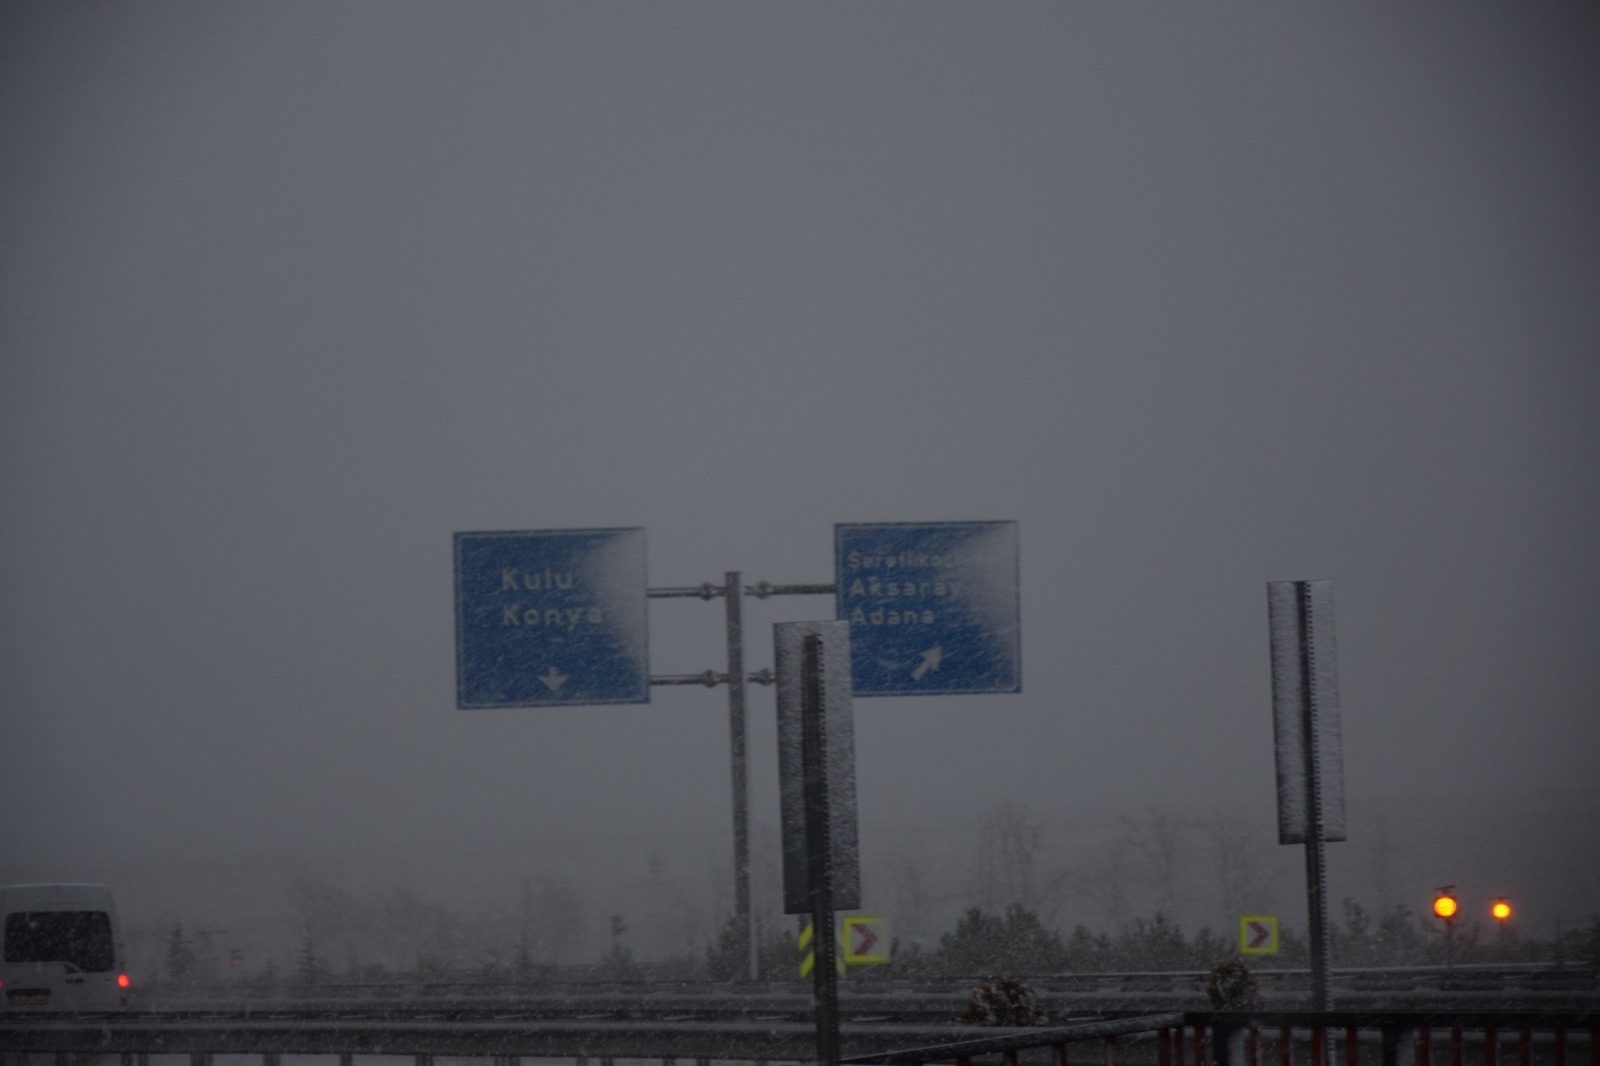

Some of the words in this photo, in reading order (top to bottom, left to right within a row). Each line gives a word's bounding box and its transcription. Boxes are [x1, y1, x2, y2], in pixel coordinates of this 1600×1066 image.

[502, 568, 574, 591] Kulu
[848, 577, 962, 601] Aksaray
[502, 603, 604, 632] Konya
[850, 606, 936, 626] Adana
